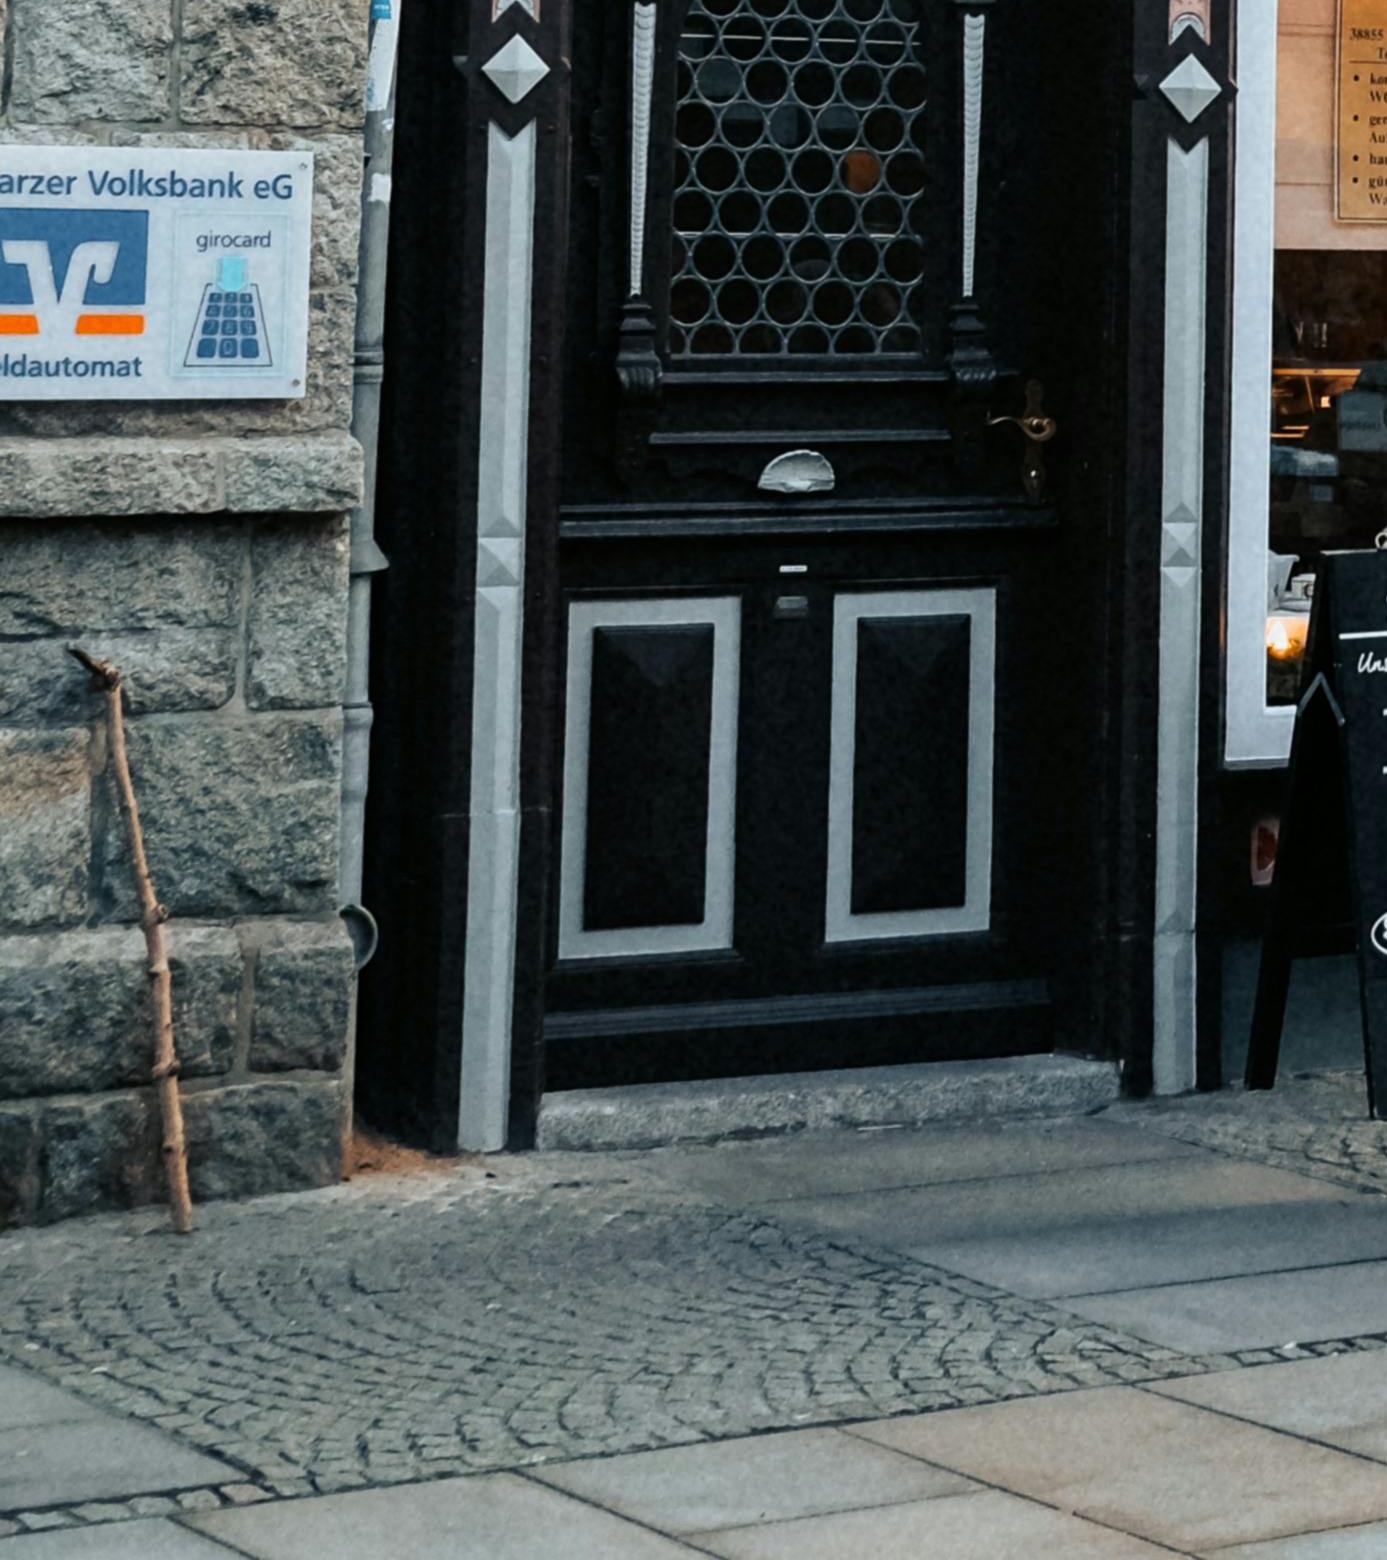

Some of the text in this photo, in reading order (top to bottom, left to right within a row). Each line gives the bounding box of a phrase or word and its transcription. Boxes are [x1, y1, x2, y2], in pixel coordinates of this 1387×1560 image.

[1349, 28, 1383, 42] 38855
[89, 169, 243, 199] Volksbank
[253, 173, 293, 199] eG
[196, 231, 271, 252] girocard
[0, 353, 142, 377] ldautomat
